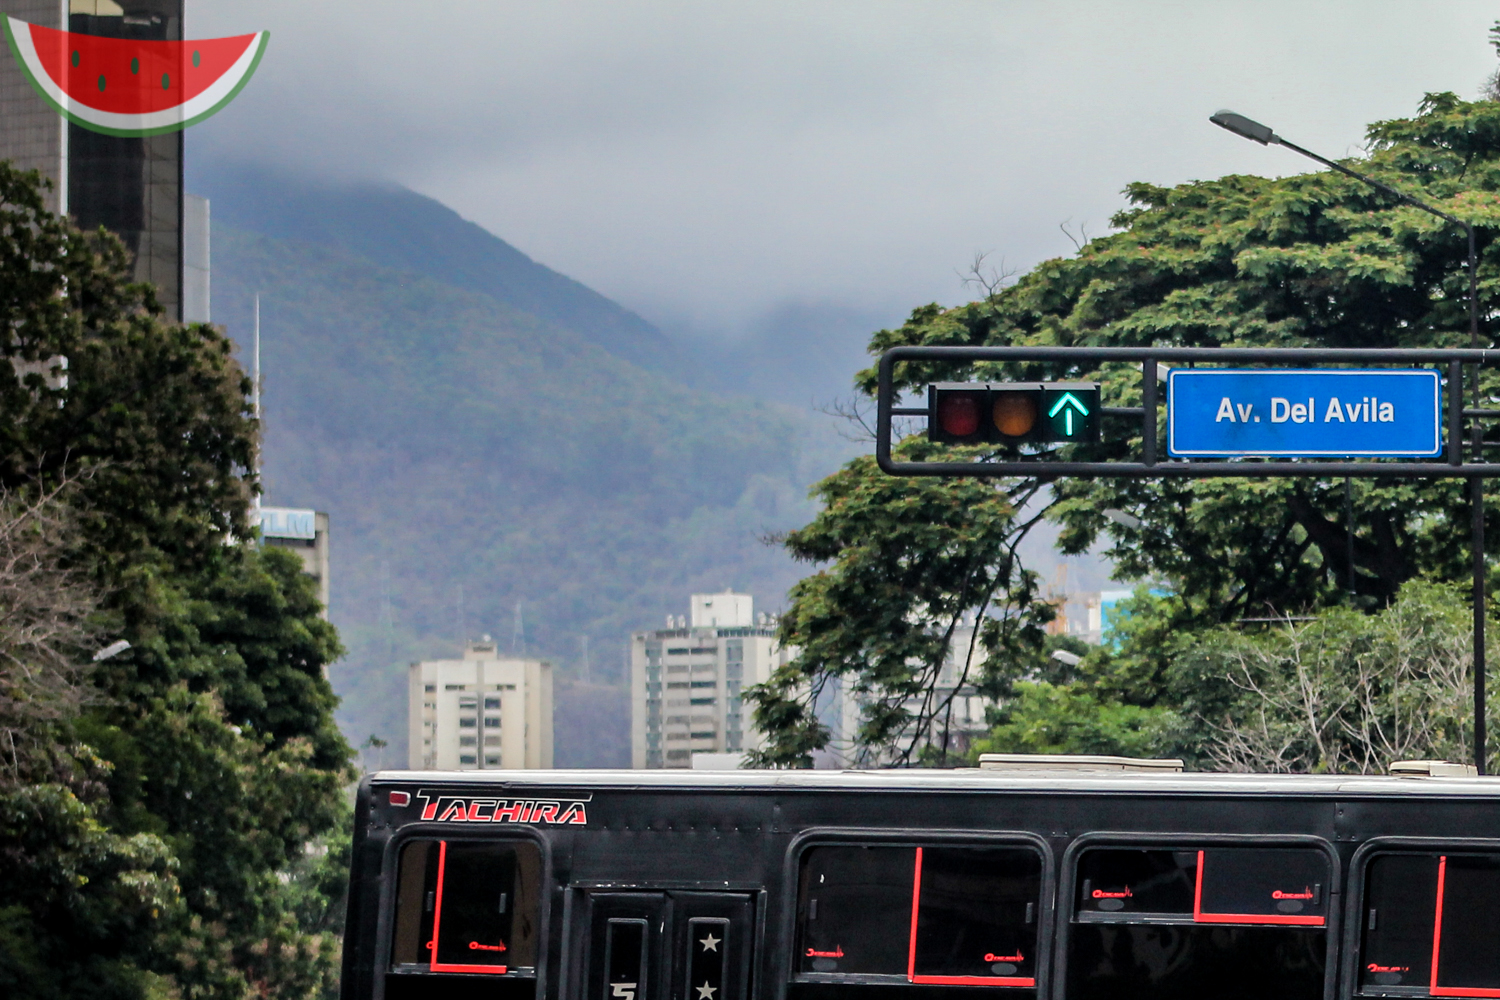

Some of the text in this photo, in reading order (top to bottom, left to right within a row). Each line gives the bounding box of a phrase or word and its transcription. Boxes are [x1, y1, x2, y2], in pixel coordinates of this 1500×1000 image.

[1215, 397, 1395, 423] Av. Del Avila
[416, 788, 593, 825] TACHIRA
